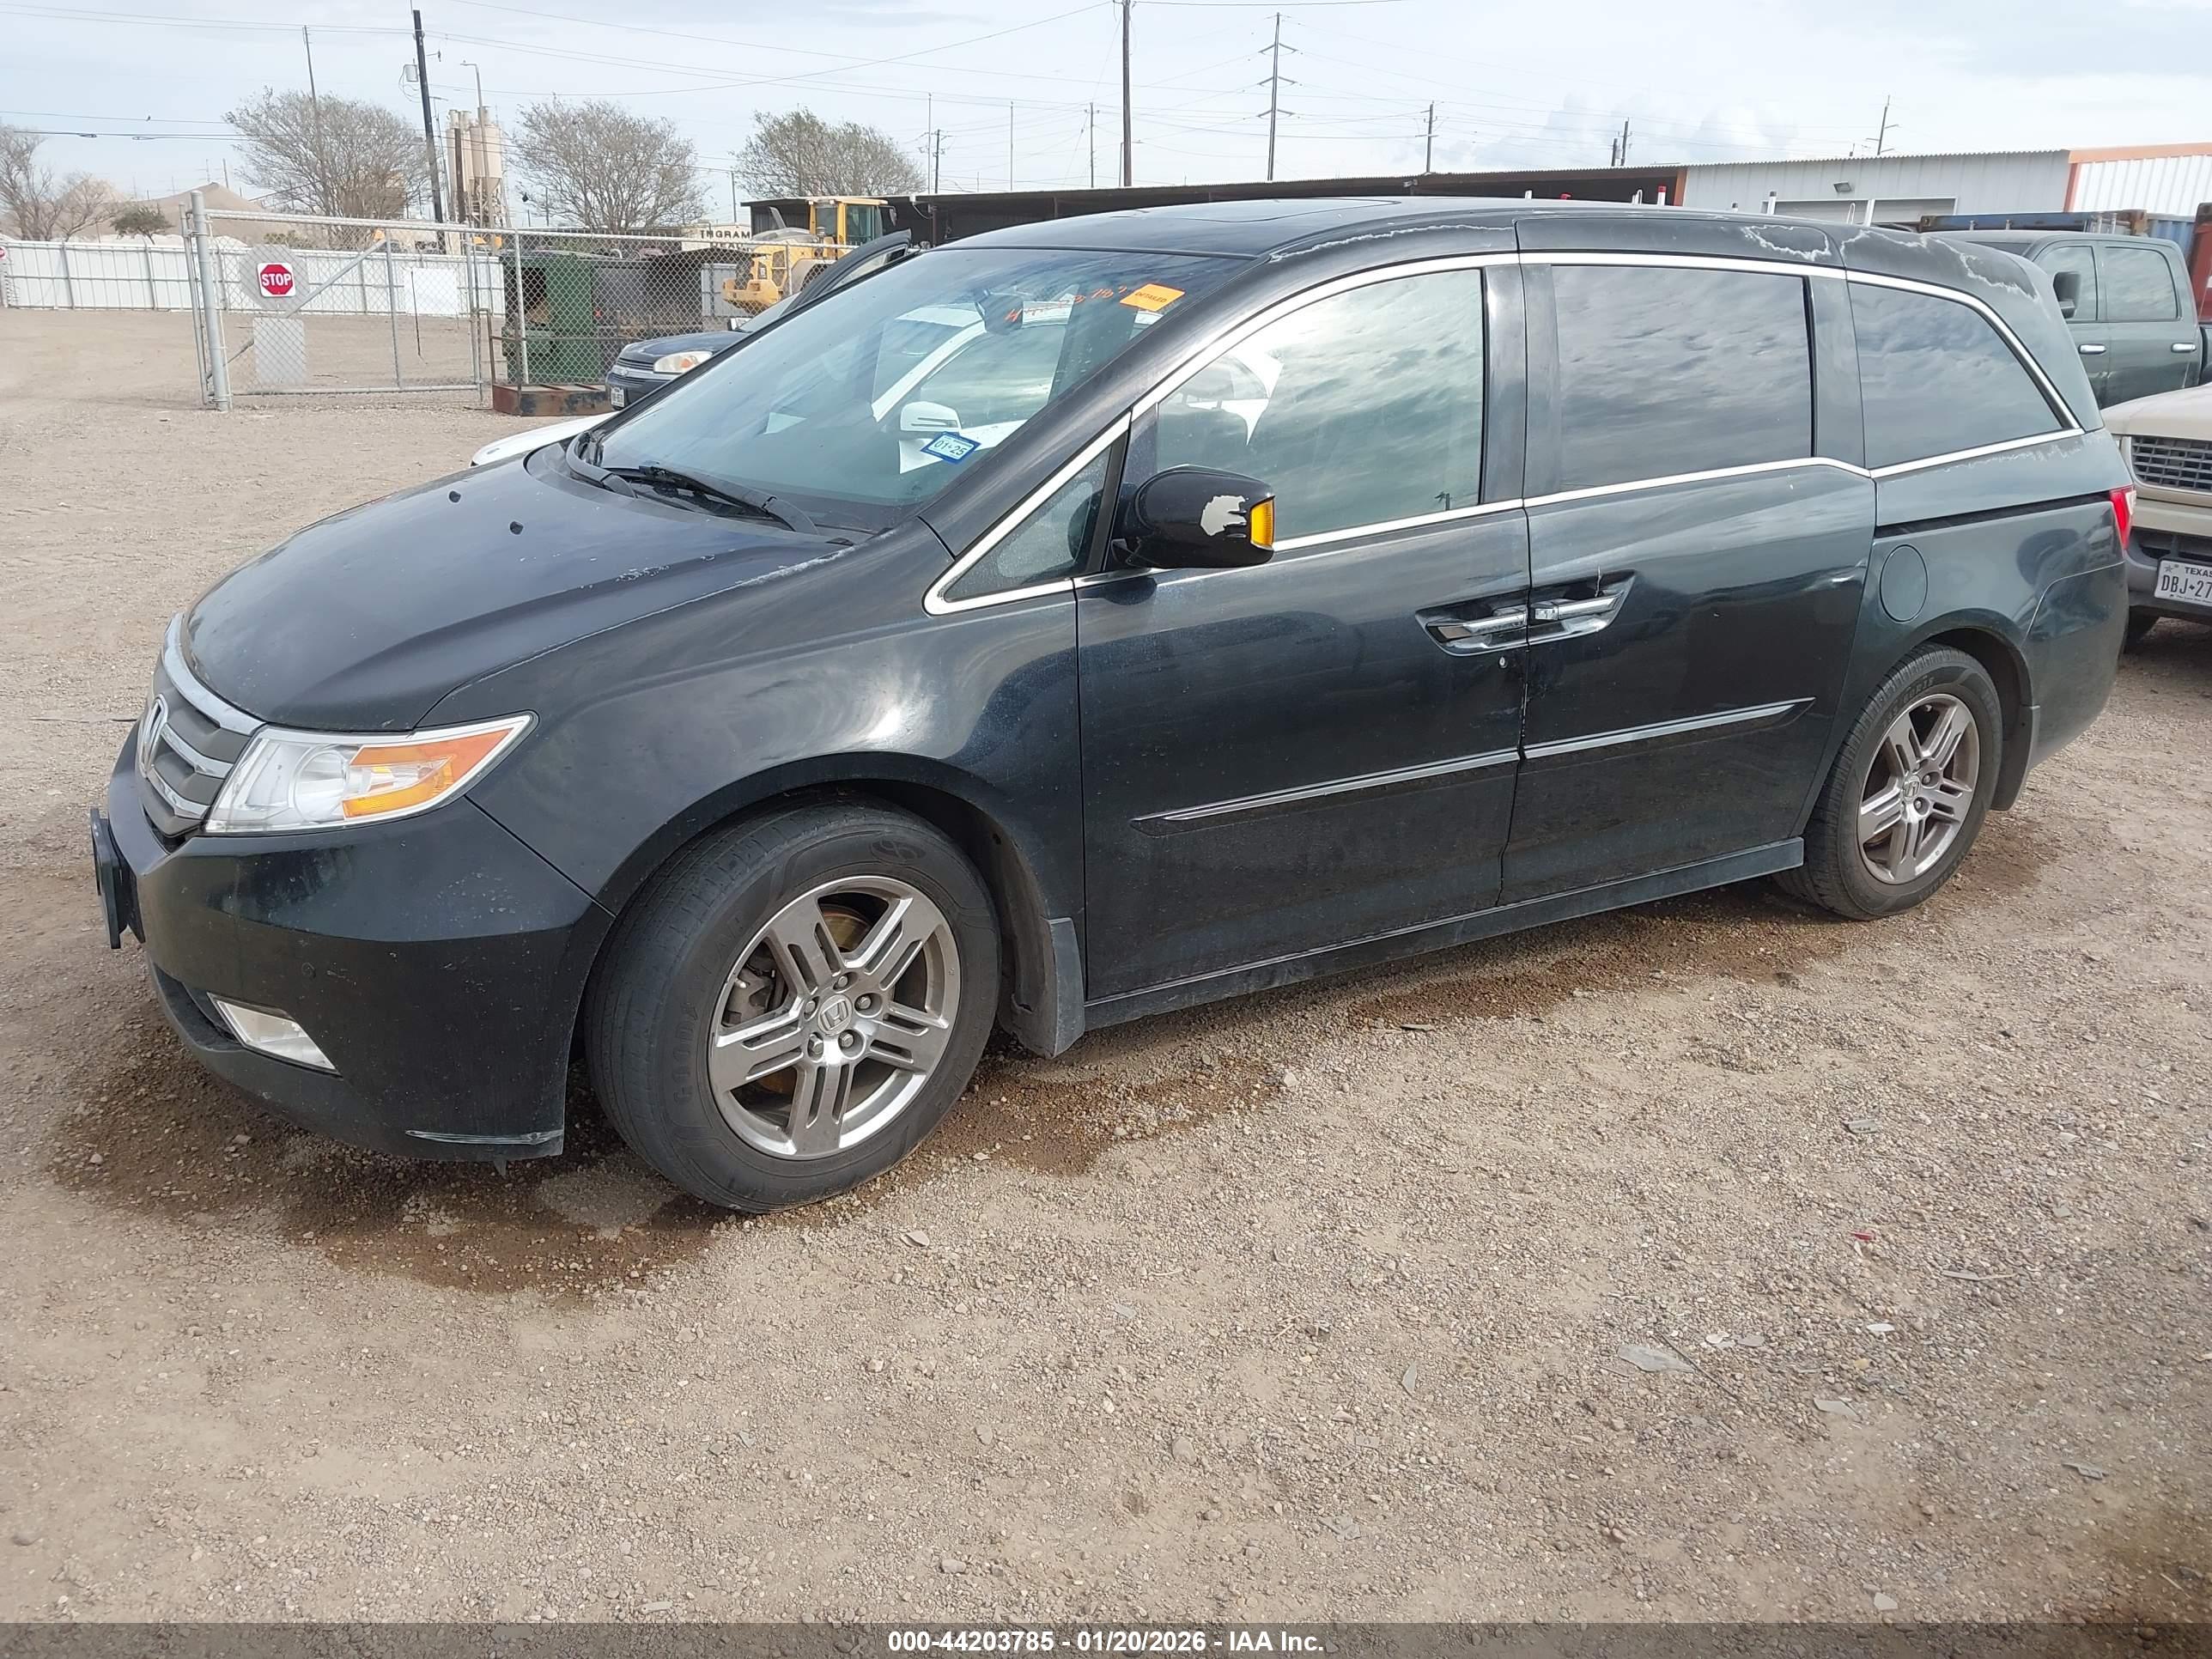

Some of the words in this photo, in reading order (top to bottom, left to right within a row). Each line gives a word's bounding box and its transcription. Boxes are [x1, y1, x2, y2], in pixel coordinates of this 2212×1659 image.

[701, 230, 750, 239] INGRAM
[261, 273, 292, 286] STOP
[2185, 567, 2212, 577] TEXAS
